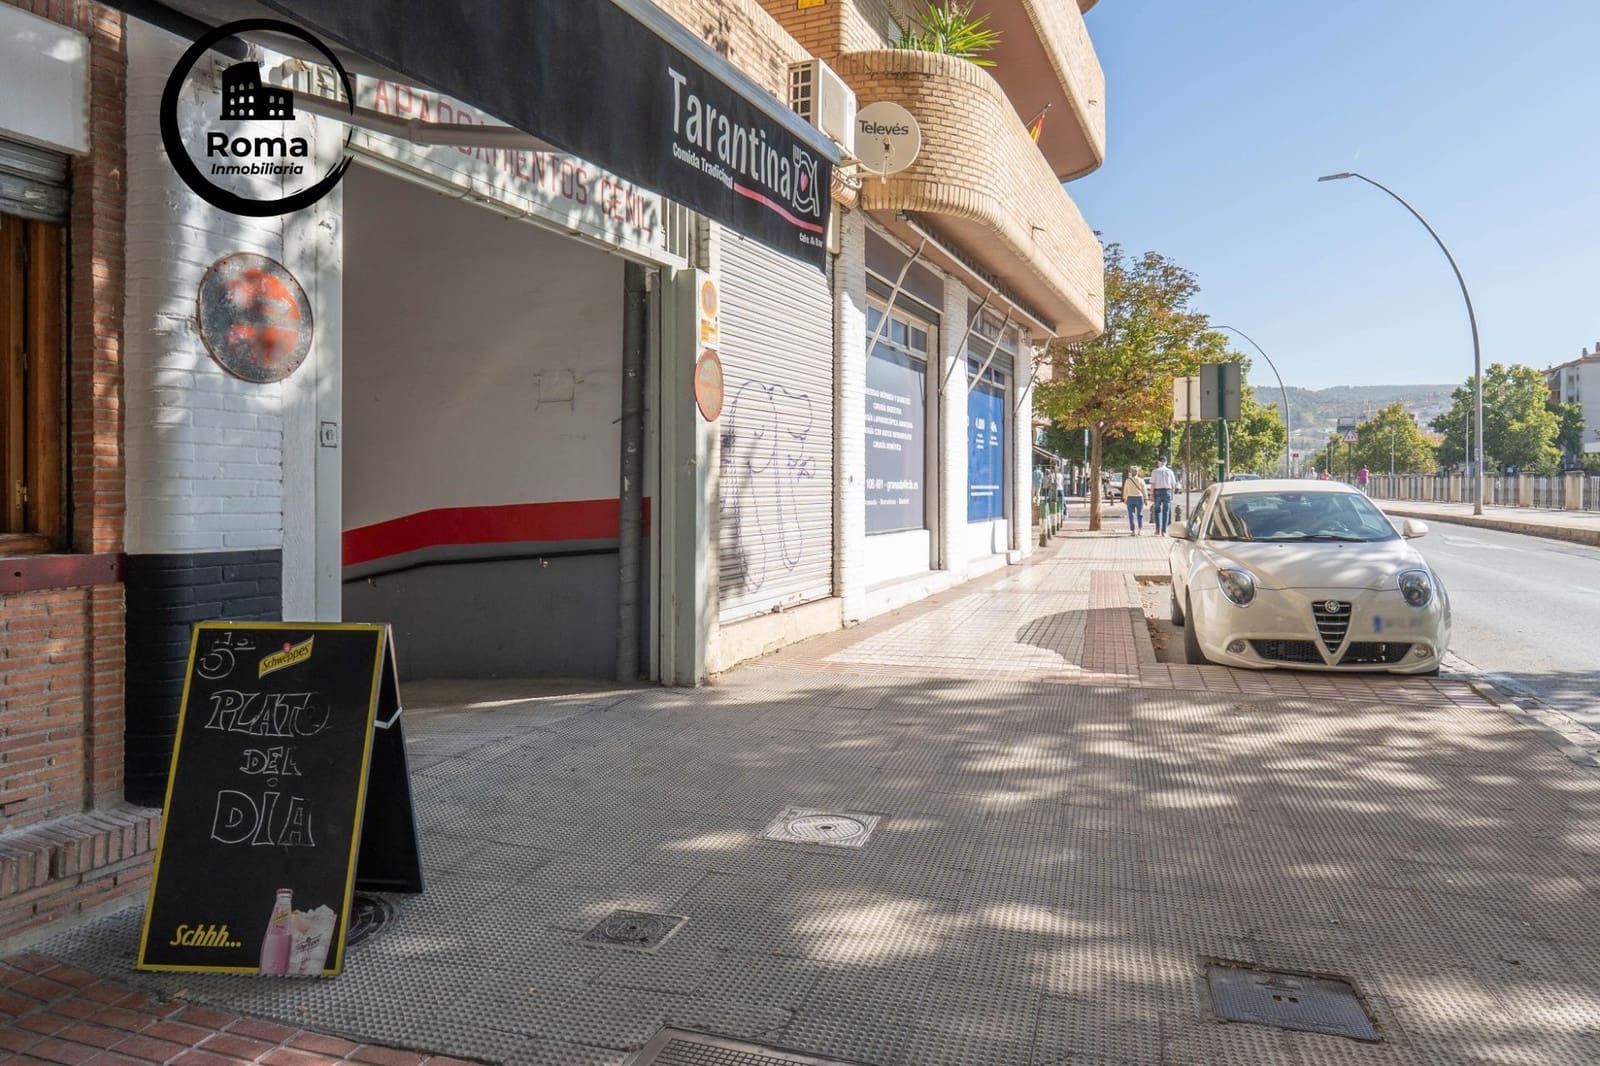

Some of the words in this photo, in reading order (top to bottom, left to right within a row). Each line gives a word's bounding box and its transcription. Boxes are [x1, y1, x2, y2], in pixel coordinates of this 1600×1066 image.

[668, 67, 791, 200] Tarantina
[858, 119, 910, 136] Televés
[672, 142, 700, 169] Comida
[601, 178, 652, 233] GENIL
[262, 644, 311, 671] Schweppes
[204, 689, 332, 738] PLATO
[169, 924, 242, 947] Schhh...
